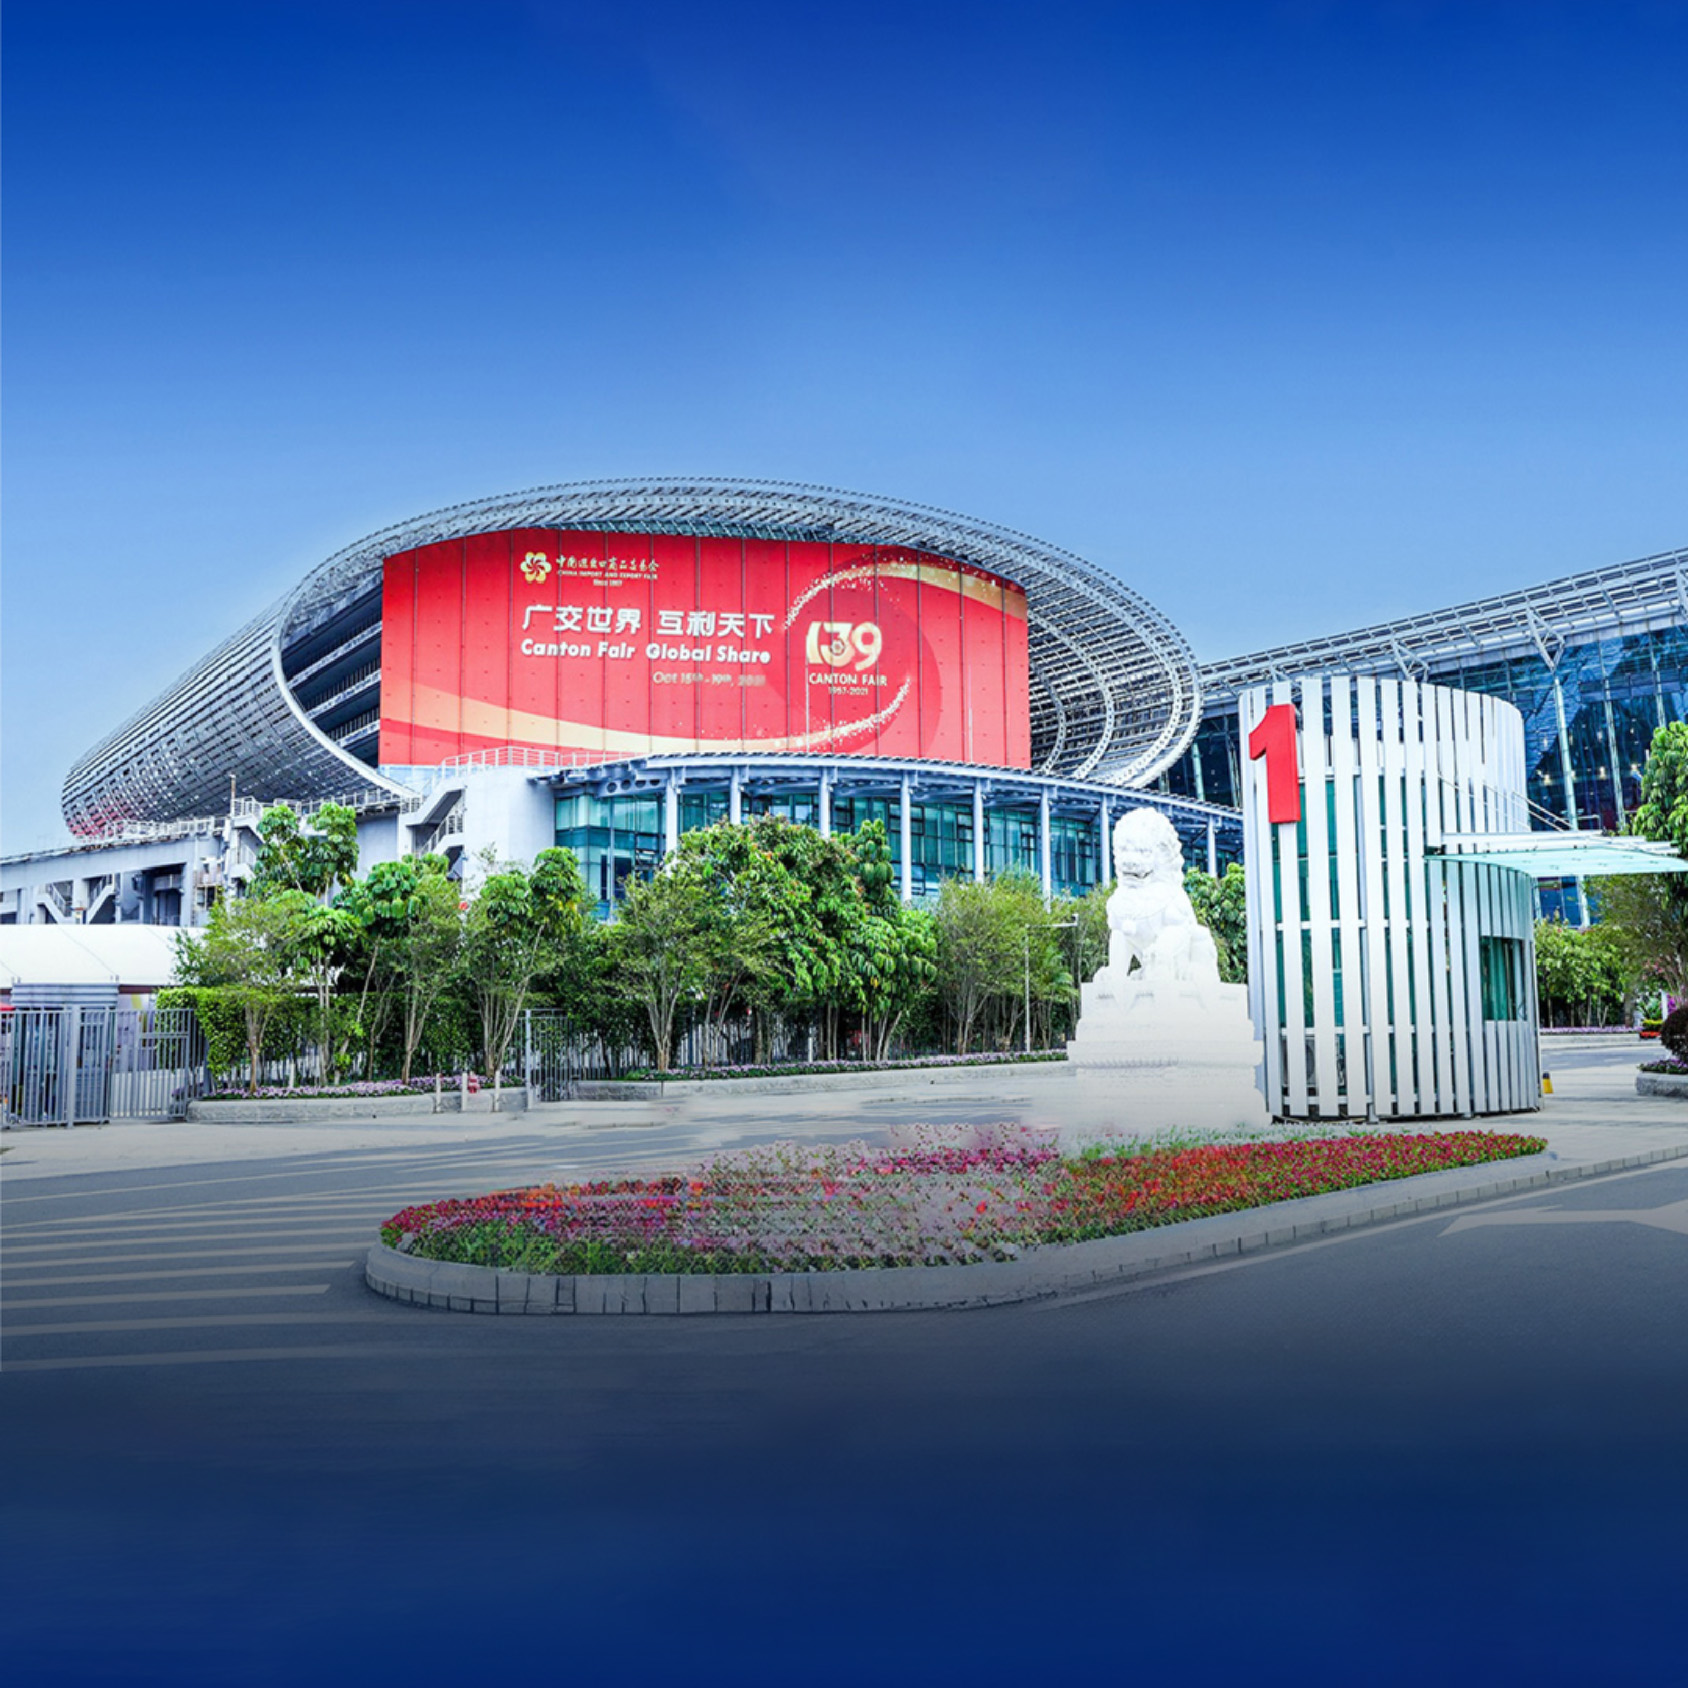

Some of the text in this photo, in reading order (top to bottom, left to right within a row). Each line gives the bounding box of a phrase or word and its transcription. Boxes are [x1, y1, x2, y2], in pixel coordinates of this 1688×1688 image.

[521, 604, 775, 639] 广交世界 互利天下
[521, 638, 771, 663] Canton Fair Global Share
[805, 621, 882, 672] 139
[653, 671, 678, 684] Oct
[808, 672, 887, 687] CANTON FAIR
[1249, 703, 1302, 824] 1
